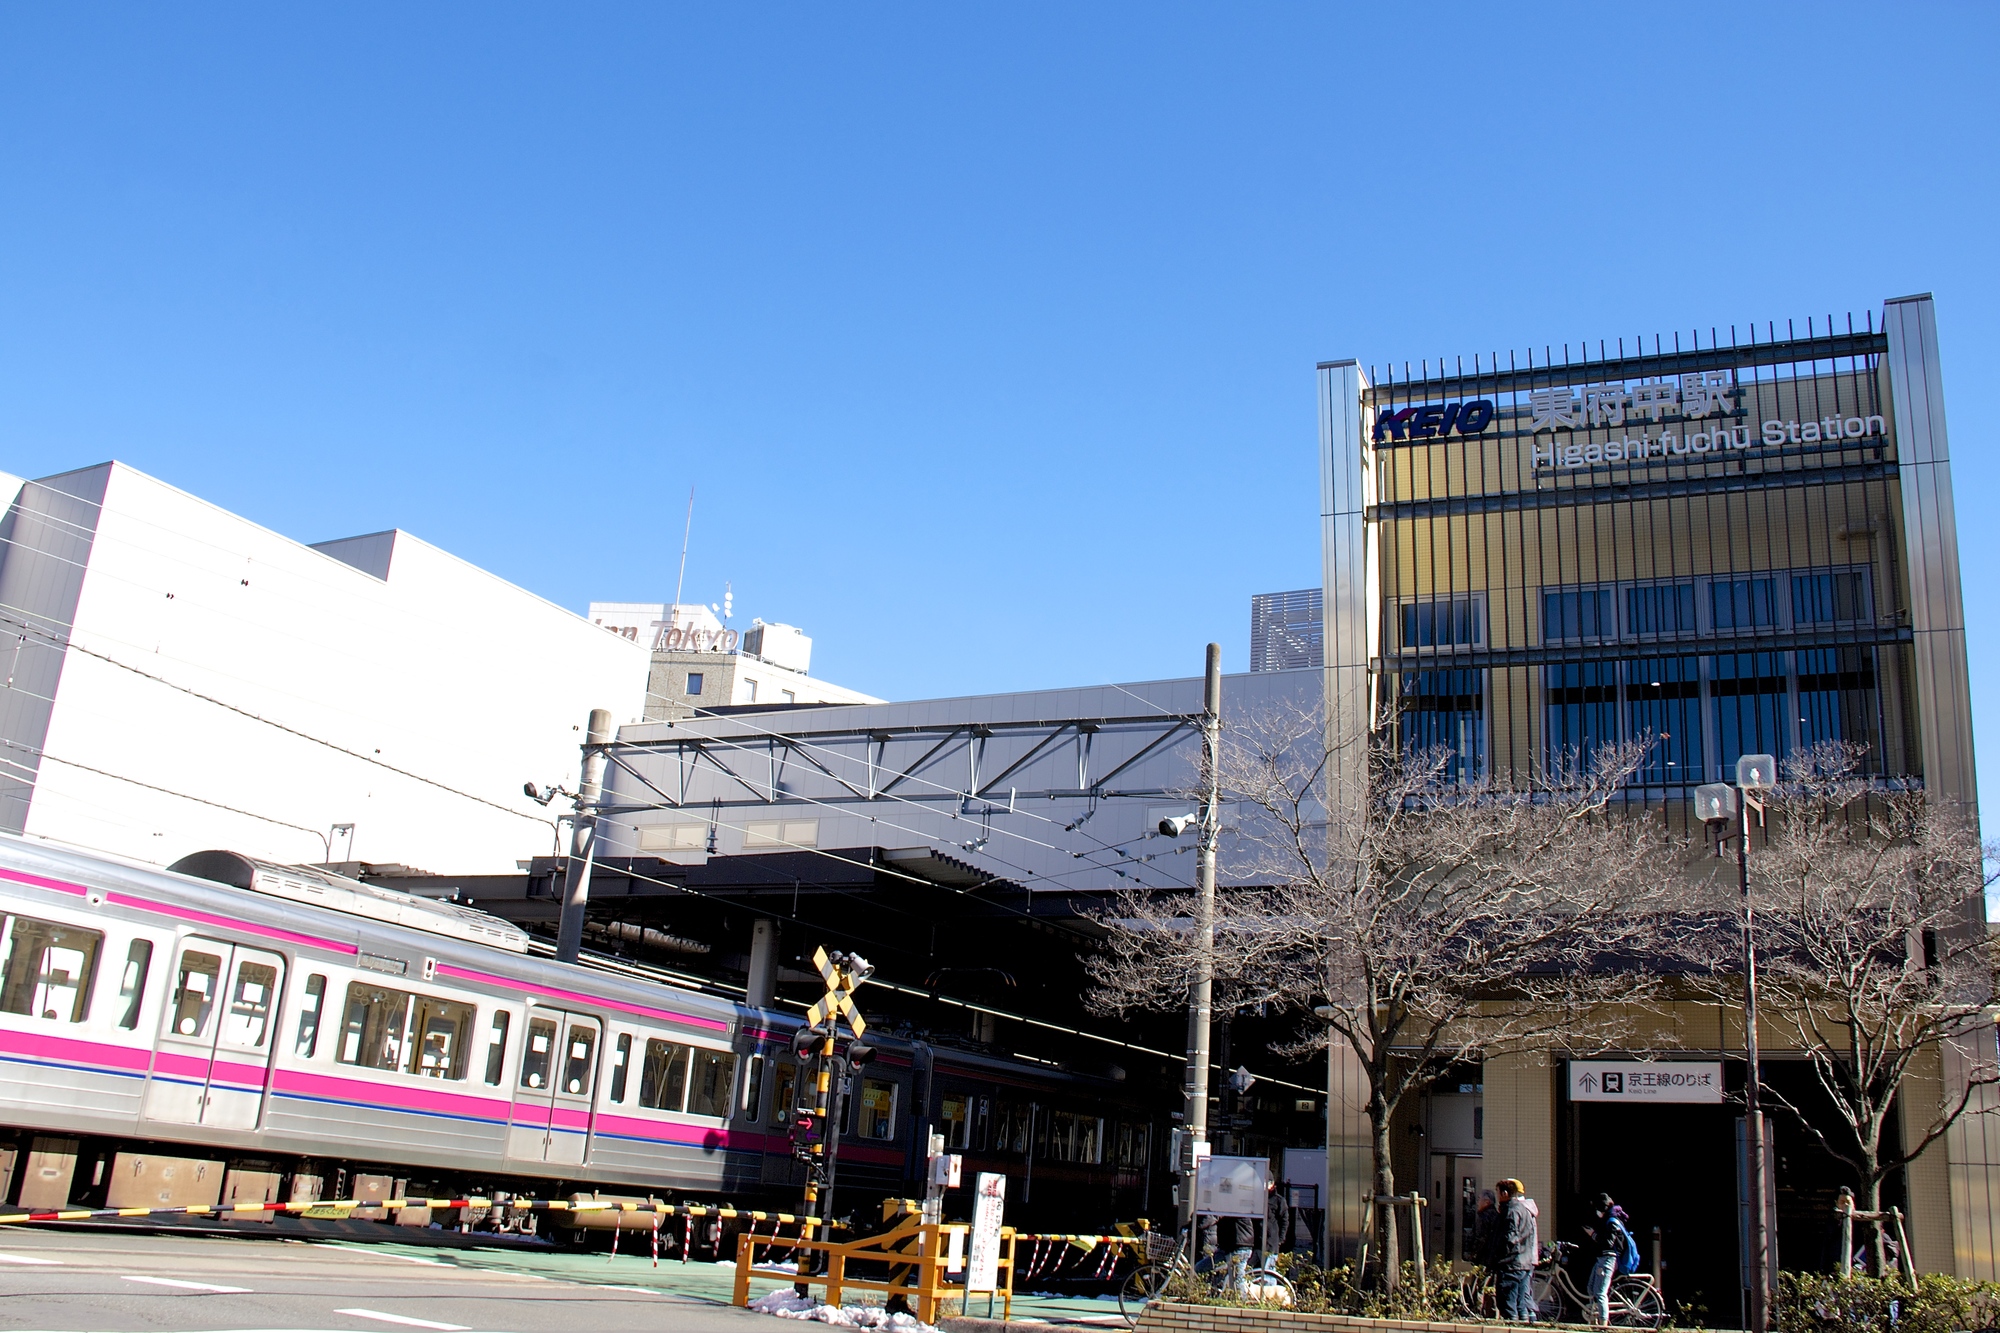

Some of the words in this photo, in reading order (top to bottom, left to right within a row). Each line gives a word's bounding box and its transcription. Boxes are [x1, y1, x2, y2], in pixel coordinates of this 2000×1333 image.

[1529, 371, 1733, 433] 東府中駅
[1371, 399, 1494, 441] KEIO
[1761, 413, 1886, 447] Station
[651, 620, 739, 651] Tokyo
[1628, 1072, 1712, 1087] 京王線のりば
